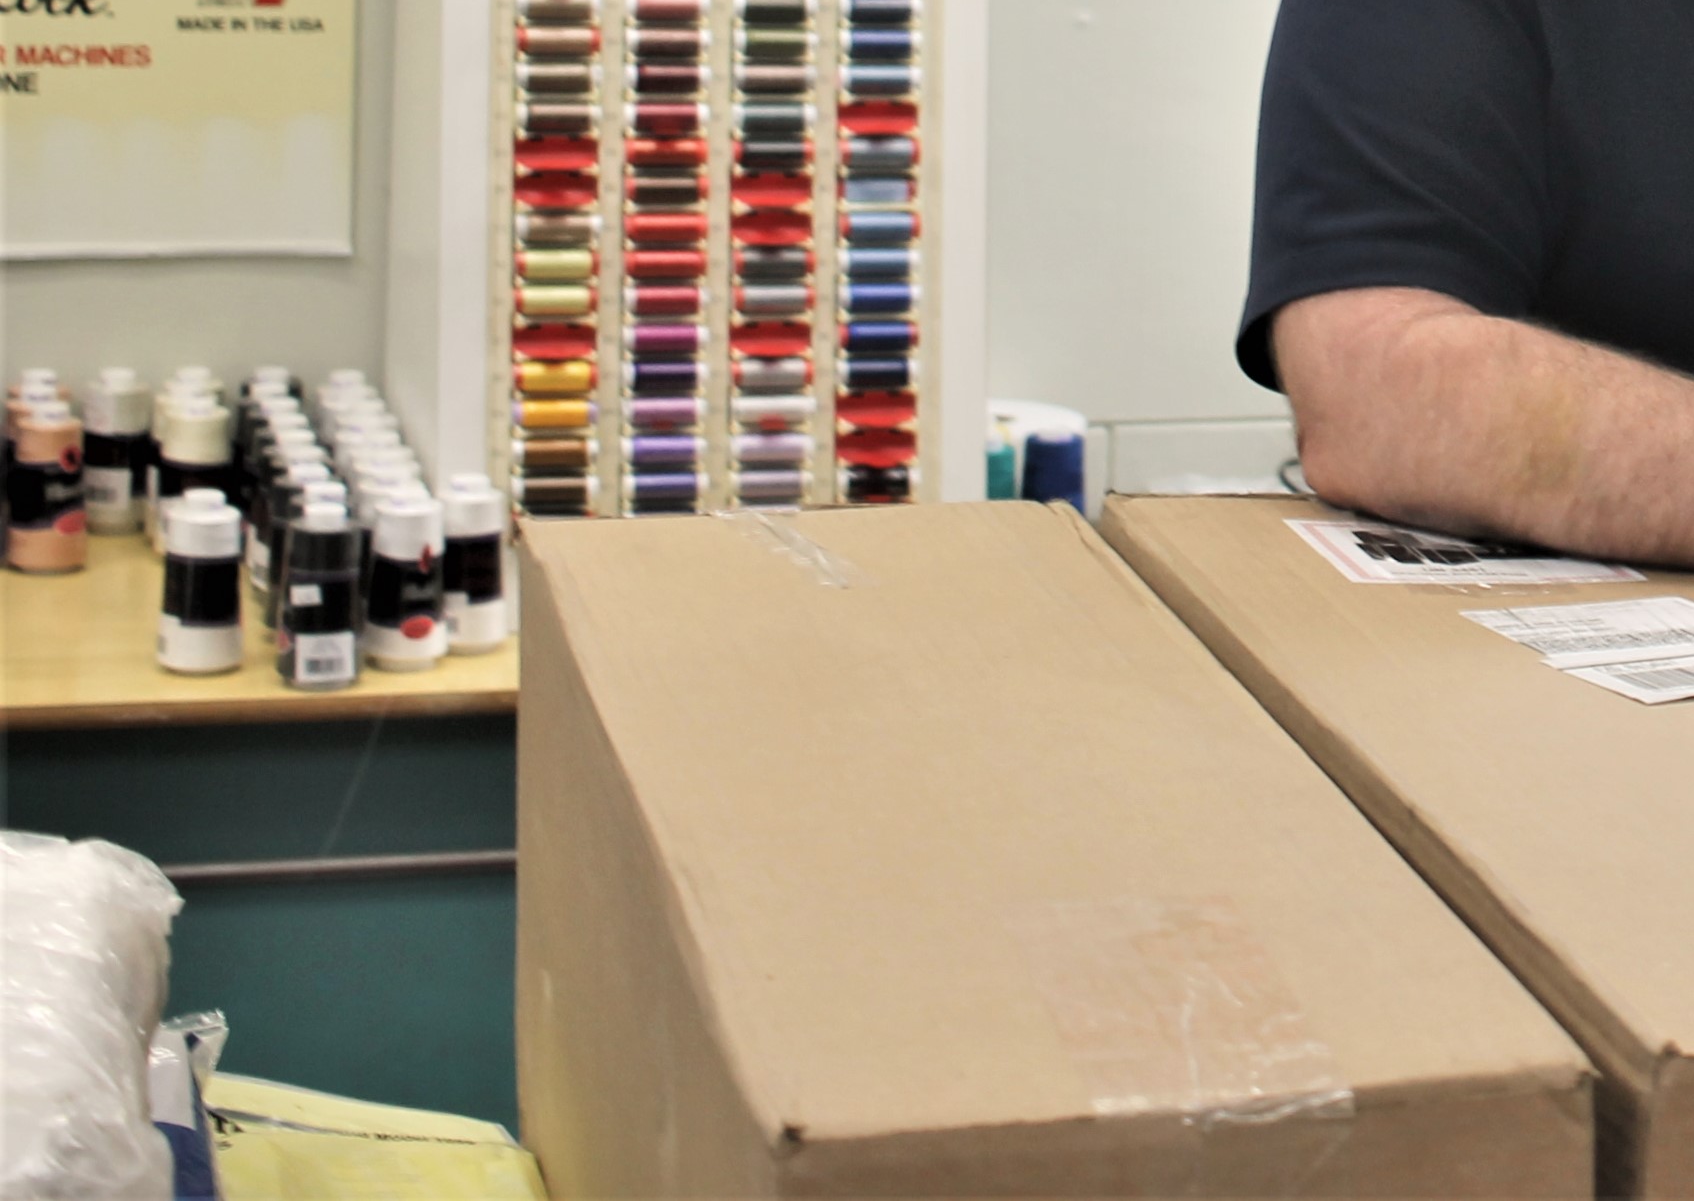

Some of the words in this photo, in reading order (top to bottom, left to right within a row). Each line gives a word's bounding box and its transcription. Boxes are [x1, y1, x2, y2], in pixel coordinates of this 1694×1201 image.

[176, 17, 225, 31] MADE
[231, 18, 247, 31] IN
[253, 18, 283, 31] THE
[290, 19, 324, 32] USA
[16, 45, 151, 67] MACHINES
